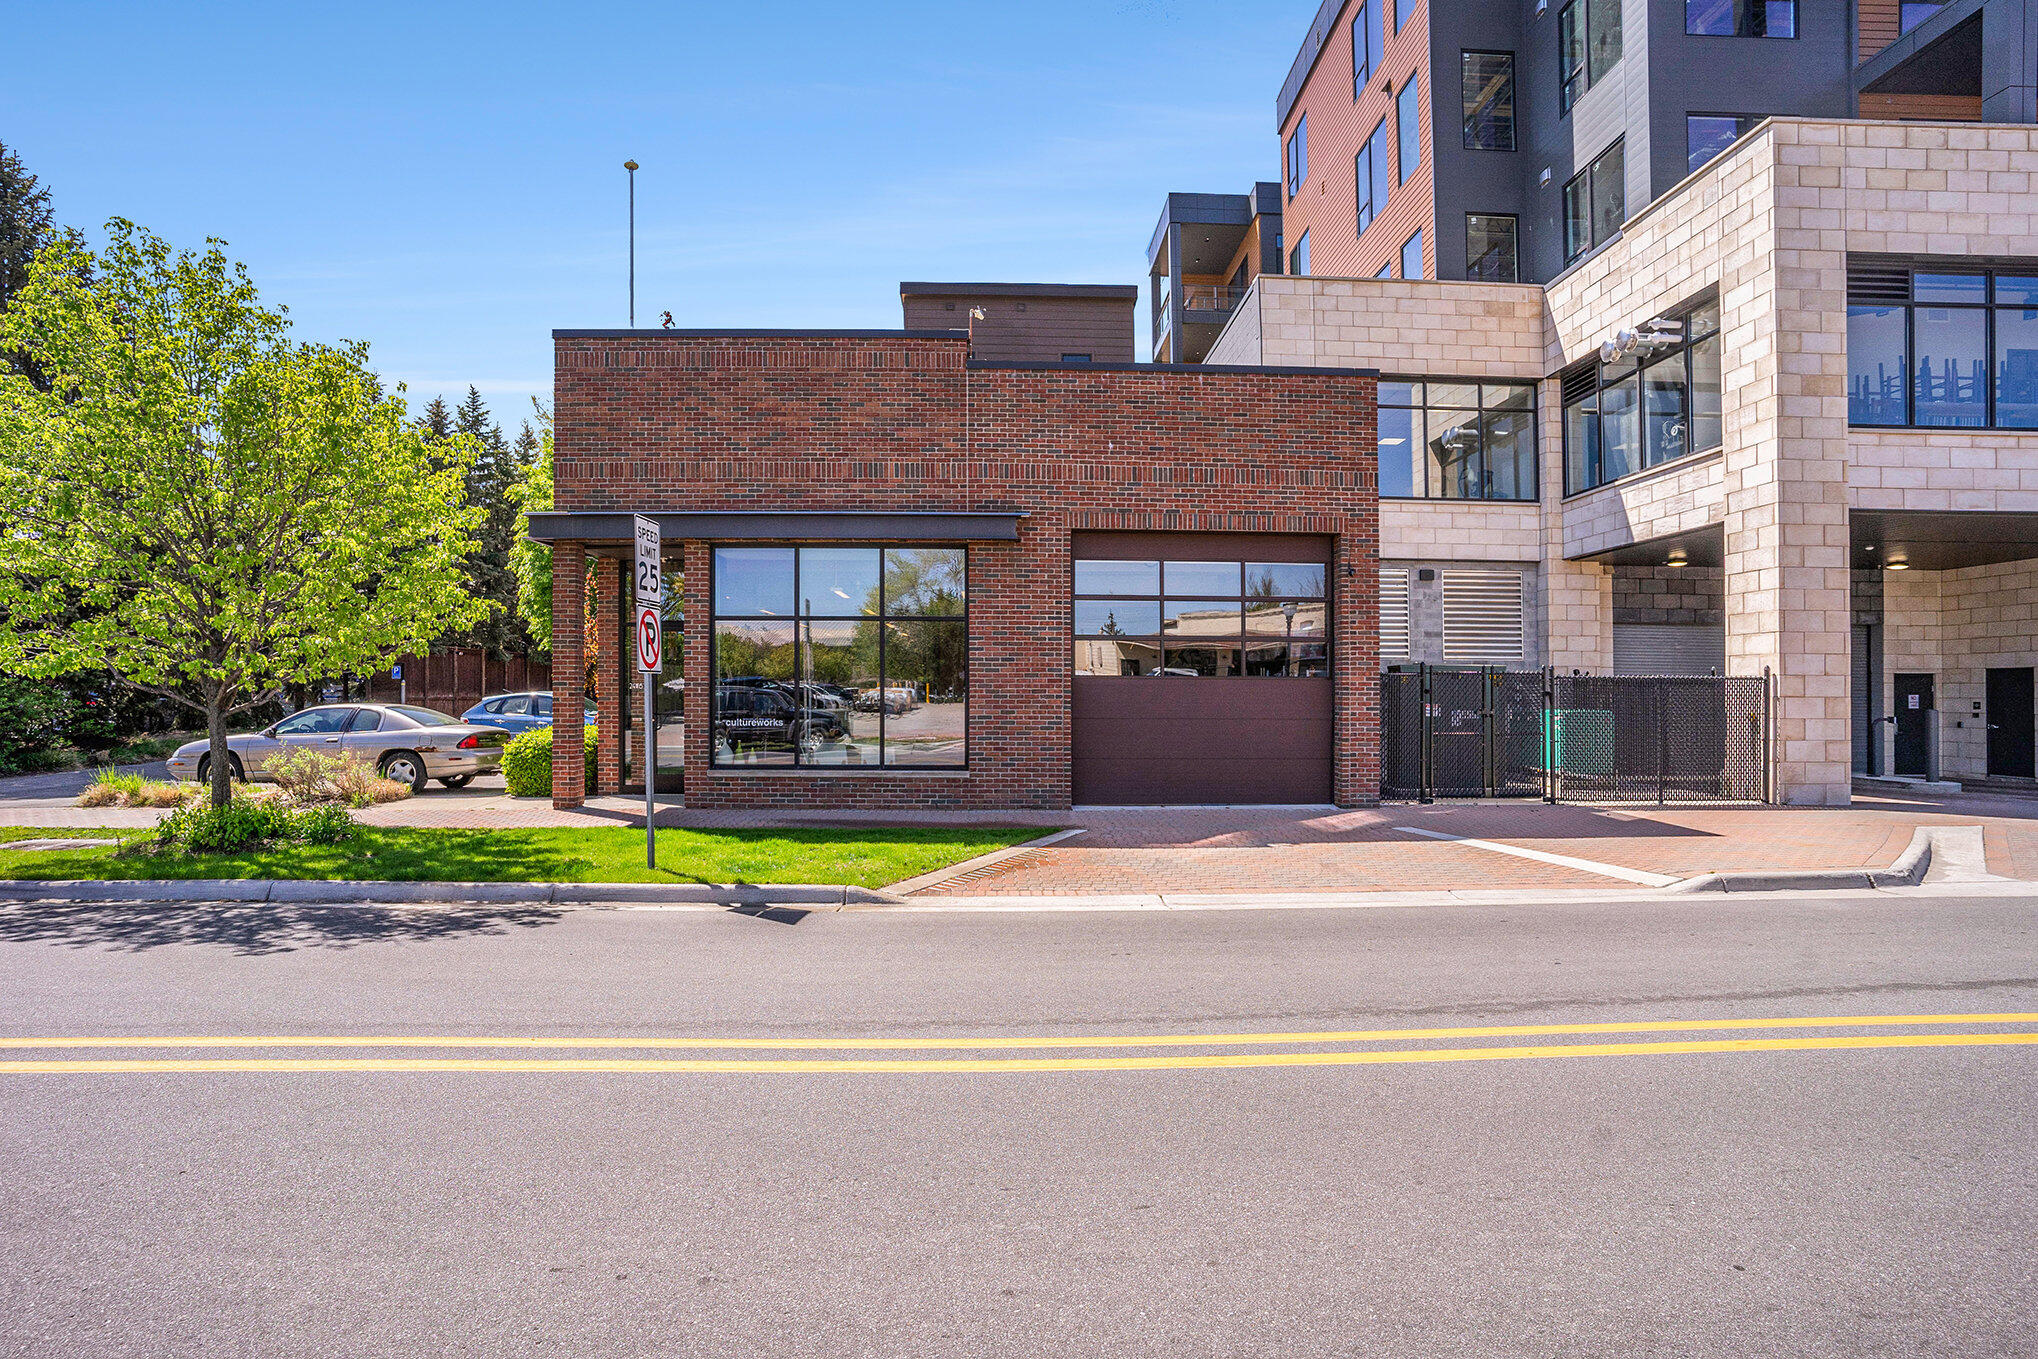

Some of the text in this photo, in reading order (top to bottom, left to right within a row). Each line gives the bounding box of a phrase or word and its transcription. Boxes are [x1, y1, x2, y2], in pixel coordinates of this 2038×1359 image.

[637, 526, 659, 544] SPEED
[640, 544, 656, 560] LIMIT
[638, 561, 659, 593] 25
[725, 718, 784, 727] cultureworks
